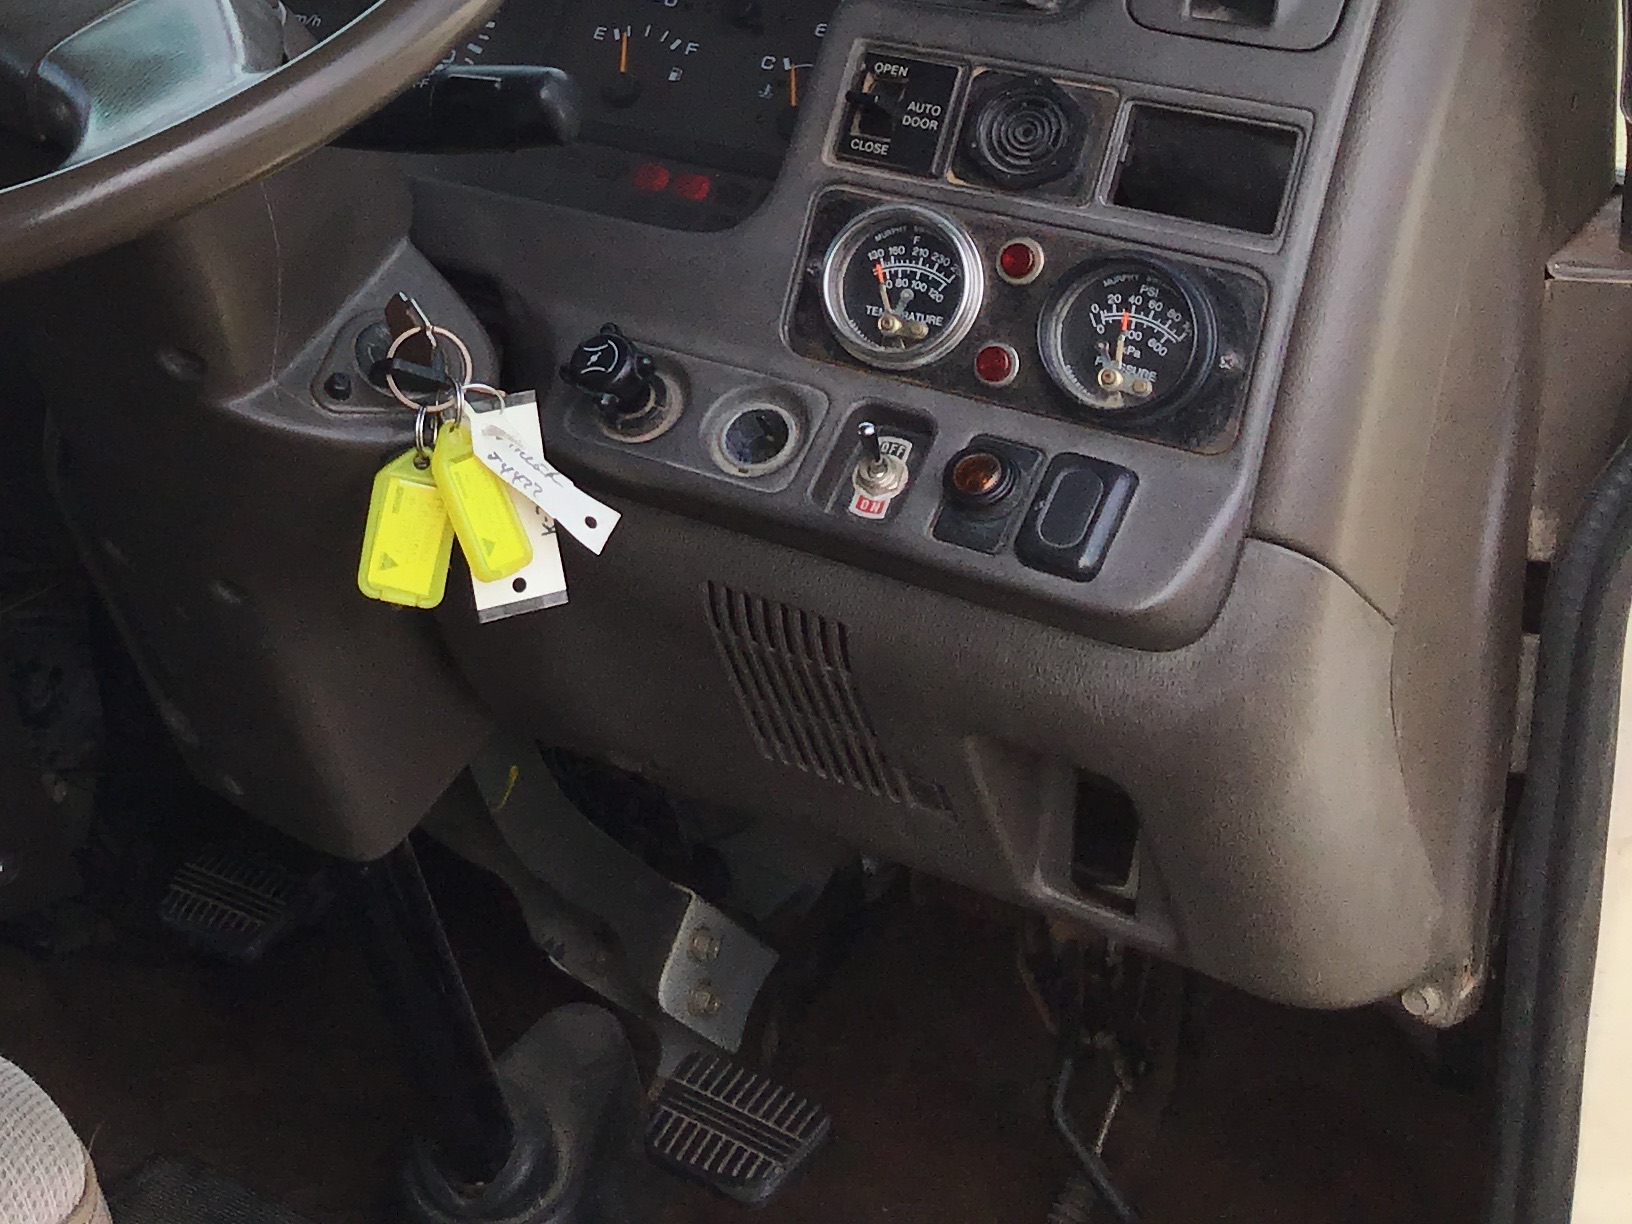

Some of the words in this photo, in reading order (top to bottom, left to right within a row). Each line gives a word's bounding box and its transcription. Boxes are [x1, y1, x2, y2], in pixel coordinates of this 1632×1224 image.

[593, 26, 607, 41] E
[685, 41, 700, 55] F
[761, 55, 776, 70] C
[874, 62, 909, 77] OPEN
[907, 101, 942, 116] AUTO
[902, 115, 939, 130] DOOR
[850, 139, 889, 155] CLOSE
[913, 235, 921, 245] F
[912, 247, 929, 258] 210
[931, 252, 951, 267] 230
[895, 278, 909, 288] 80
[911, 281, 928, 293] 100
[928, 287, 944, 303] 120
[1140, 284, 1159, 298] PSI
[1090, 303, 1100, 314] 0
[1107, 293, 1122, 305] 20
[1128, 295, 1143, 306] 40
[1148, 299, 1163, 312] 60
[1096, 323, 1106, 335] 0
[1147, 338, 1168, 357] 600
[881, 442, 906, 457] OFF
[859, 499, 882, 513] ON
